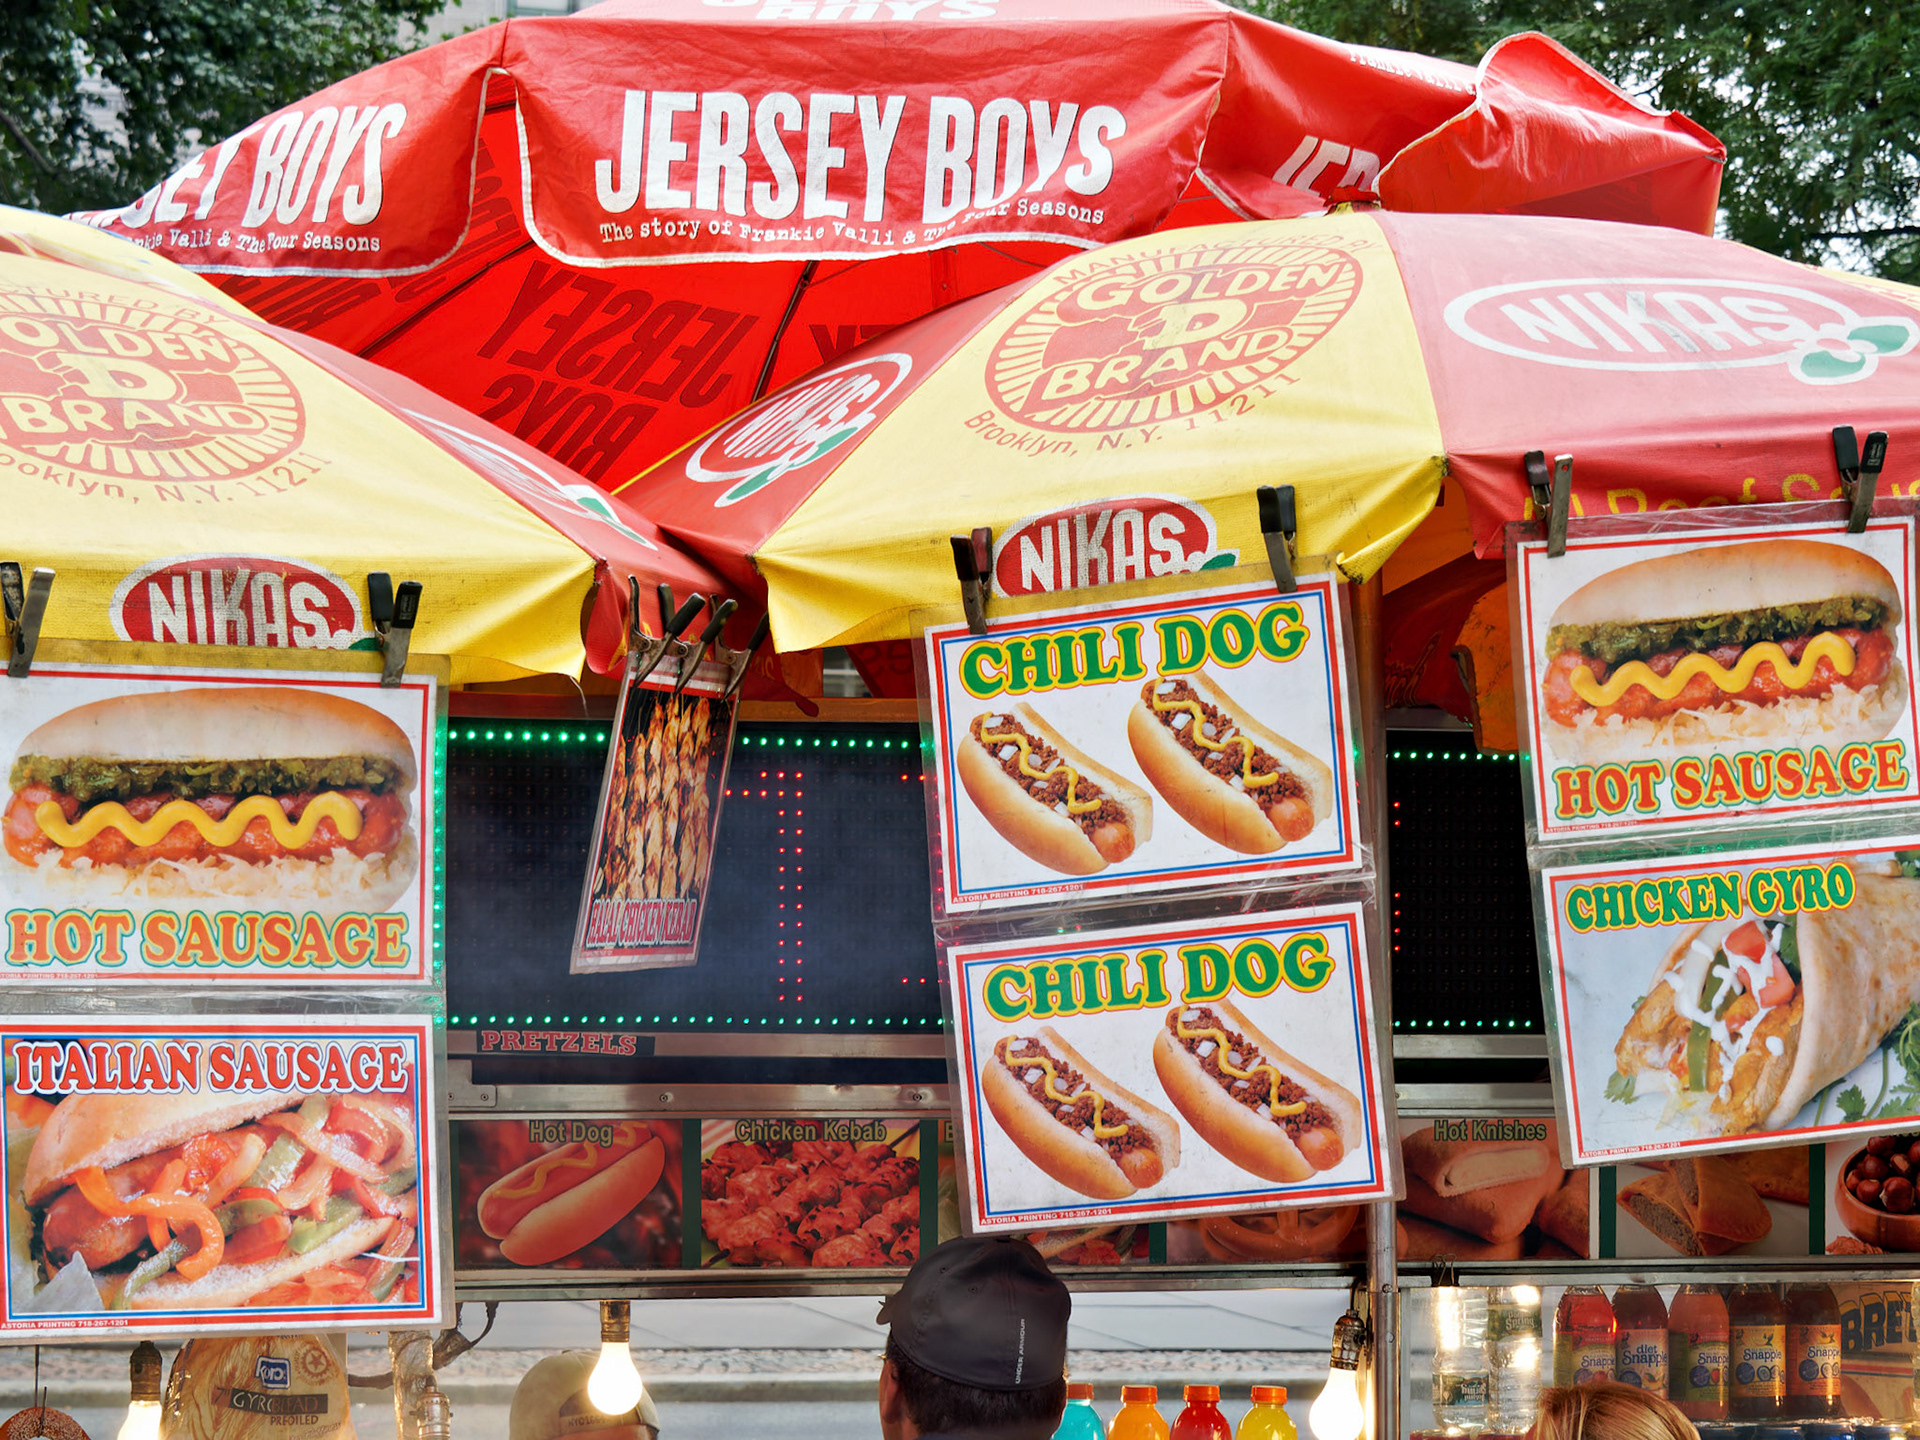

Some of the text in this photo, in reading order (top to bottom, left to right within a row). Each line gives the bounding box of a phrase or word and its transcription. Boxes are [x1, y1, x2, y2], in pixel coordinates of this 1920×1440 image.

[241, 103, 407, 228] BOYS
[594, 89, 1128, 224] JERSEY BOYS
[169, 228, 213, 248] Valli
[217, 232, 232, 248] &
[239, 236, 268, 254] The
[303, 232, 382, 253] Seasons
[600, 222, 634, 243] The
[640, 217, 702, 240] story
[708, 219, 733, 236] of
[739, 222, 826, 242] Frankie
[832, 219, 895, 246] Valli
[902, 231, 918, 245] &
[1016, 197, 1105, 225] Seasons
[1076, 261, 1342, 312] GOLDEN
[174, 307, 231, 324] BY
[1498, 290, 1806, 354] NIKAS
[1040, 328, 1289, 401] BRAND
[1, 397, 268, 437] BRAND
[963, 373, 1301, 458] Brooklyn, N.Y. 11211
[153, 484, 235, 504] N.Y.
[237, 450, 334, 498] 11211
[1019, 508, 1188, 594] NIKAS
[147, 567, 335, 650] NIKAS
[960, 622, 1148, 699] CHILI
[1154, 601, 1311, 678] DOG
[1553, 738, 1909, 819] HOT SAUSAGE
[953, 894, 988, 904] ASTORIA
[989, 889, 1030, 900] PRINTING
[1564, 862, 1858, 934] CHICKEN GYRO
[5, 908, 411, 969] HOT SAUSAGE
[983, 932, 1335, 1022] CHILI DOG
[12, 1041, 409, 1095] ITALIAN SAUSAGE
[481, 1030, 638, 1057] PRETZELS
[529, 1120, 614, 1148] Hot Dog
[735, 1120, 887, 1142] Chicken Kebab
[1433, 1117, 1547, 1141] Hot Knishes
[981, 1216, 1017, 1225] ASTORIA
[1018, 1212, 1058, 1223] PRINTING
[1, 1321, 36, 1330] ASTORIA
[38, 1320, 77, 1329] PRINTING
[1636, 1343, 1658, 1354] diet
[1621, 1350, 1668, 1368] Snapple
[1742, 1348, 1782, 1363] Snapple
